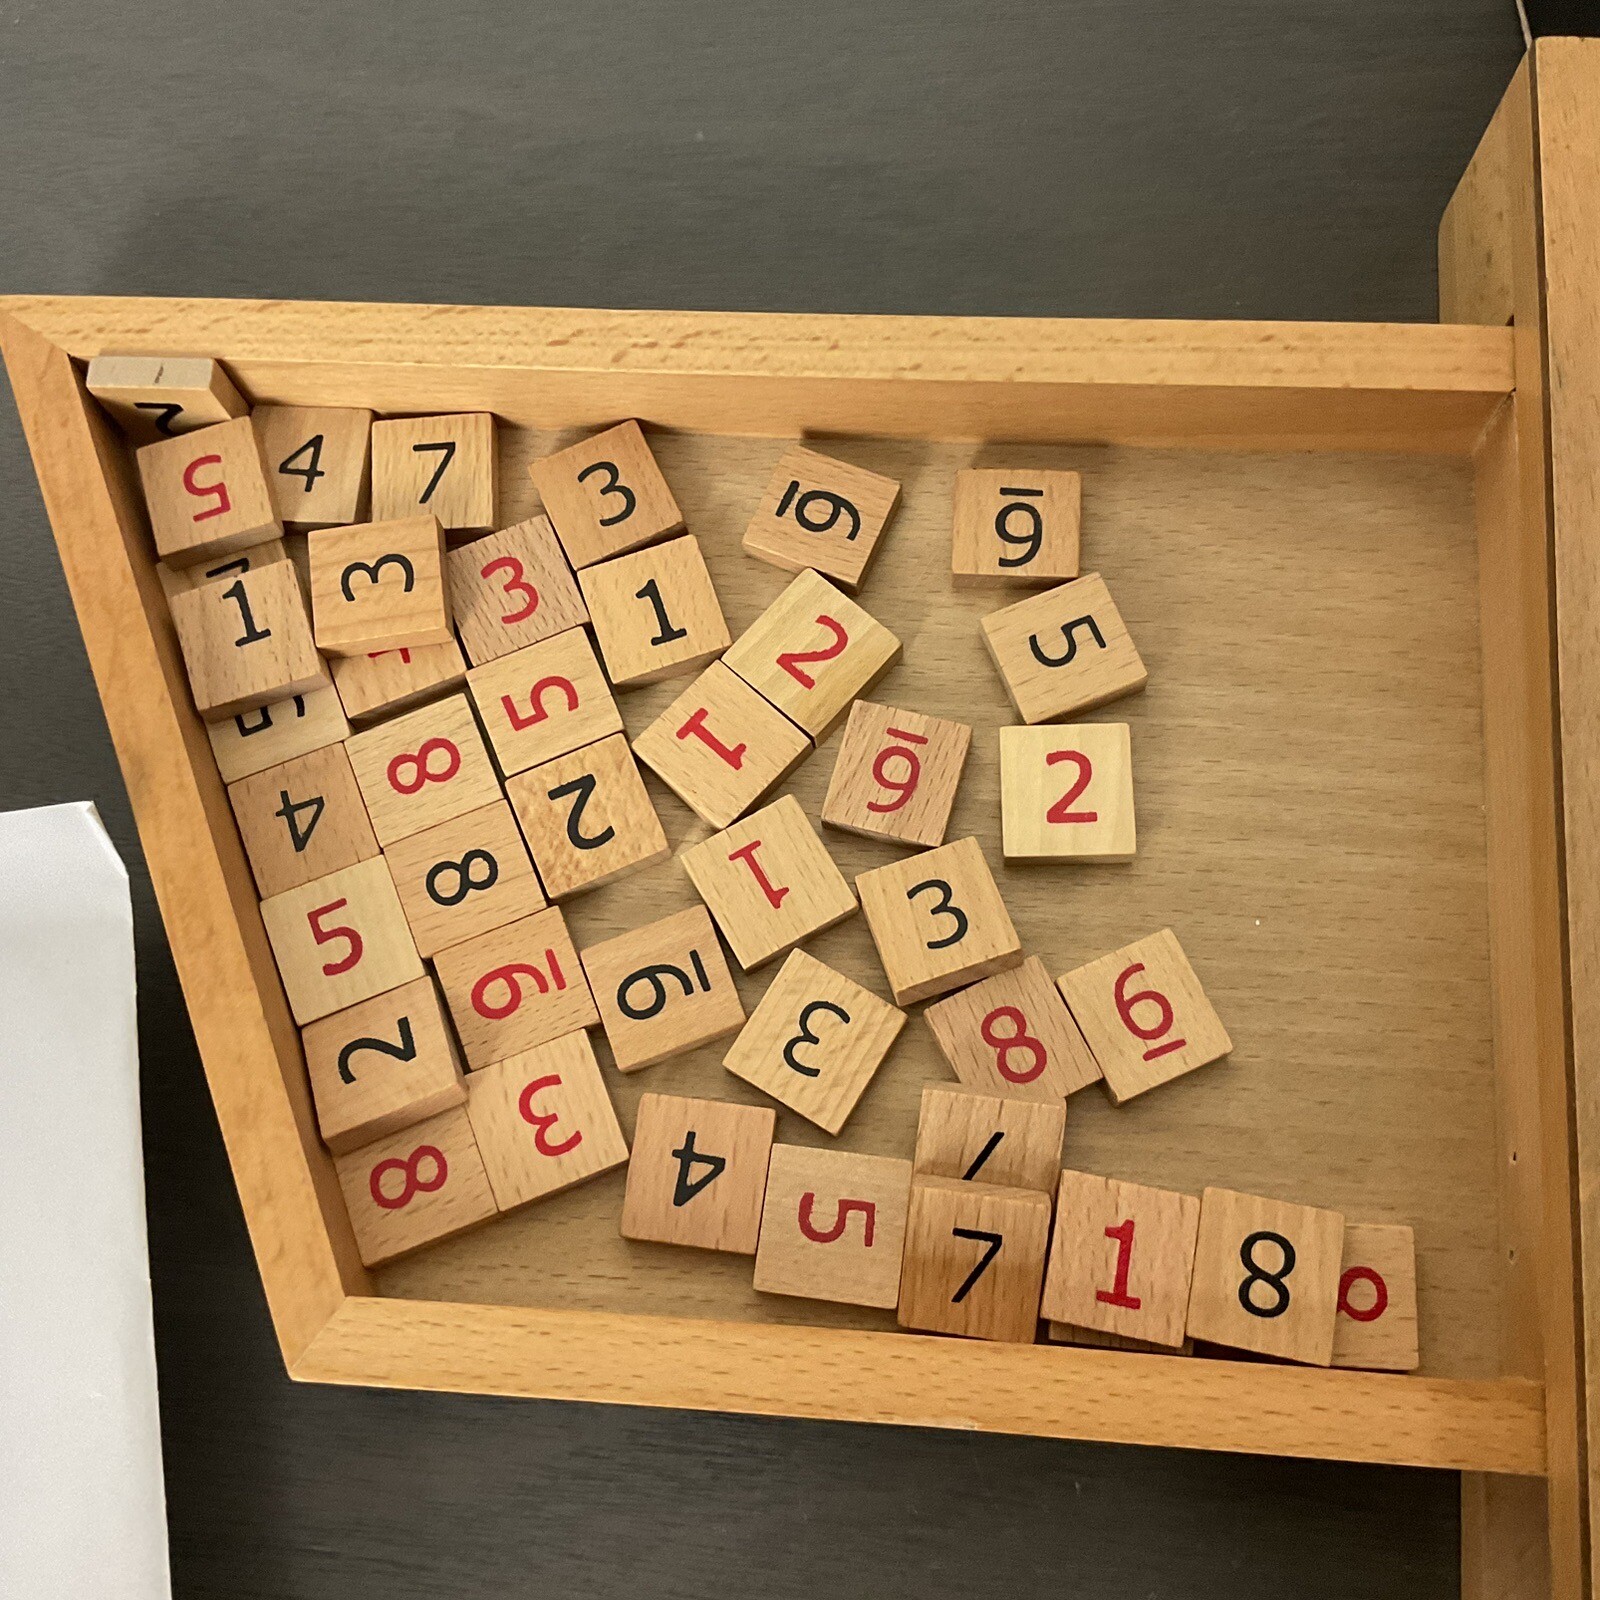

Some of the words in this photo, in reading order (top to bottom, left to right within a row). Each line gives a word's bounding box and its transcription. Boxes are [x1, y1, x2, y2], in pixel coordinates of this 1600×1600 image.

[184, 455, 230, 521] 5
[279, 435, 324, 492] 4
[413, 442, 455, 503] 7
[578, 462, 635, 526] 3
[341, 554, 414, 602] 3
[481, 557, 538, 625] 3
[223, 580, 271, 647] 1
[636, 579, 686, 646] 1
[1029, 615, 1106, 668] 5
[778, 616, 848, 690] 2
[502, 677, 578, 732] 5
[387, 738, 460, 795] 8
[677, 709, 747, 770] 1
[548, 774, 614, 850] 2
[1047, 751, 1097, 824] 2
[276, 791, 324, 853] 4
[426, 849, 498, 906] 8
[729, 841, 789, 909] 1
[309, 900, 363, 977] 5
[907, 880, 968, 950] 3
[338, 1017, 416, 1085] 2
[784, 1001, 850, 1078] 3
[982, 1006, 1047, 1085] 8
[519, 1076, 582, 1157] 3
[370, 1145, 449, 1210] 8
[672, 1131, 725, 1207] 4
[799, 1193, 875, 1246] 5
[952, 1228, 1002, 1304] 7
[1096, 1220, 1141, 1310] 1
[1239, 1232, 1295, 1319] 8
